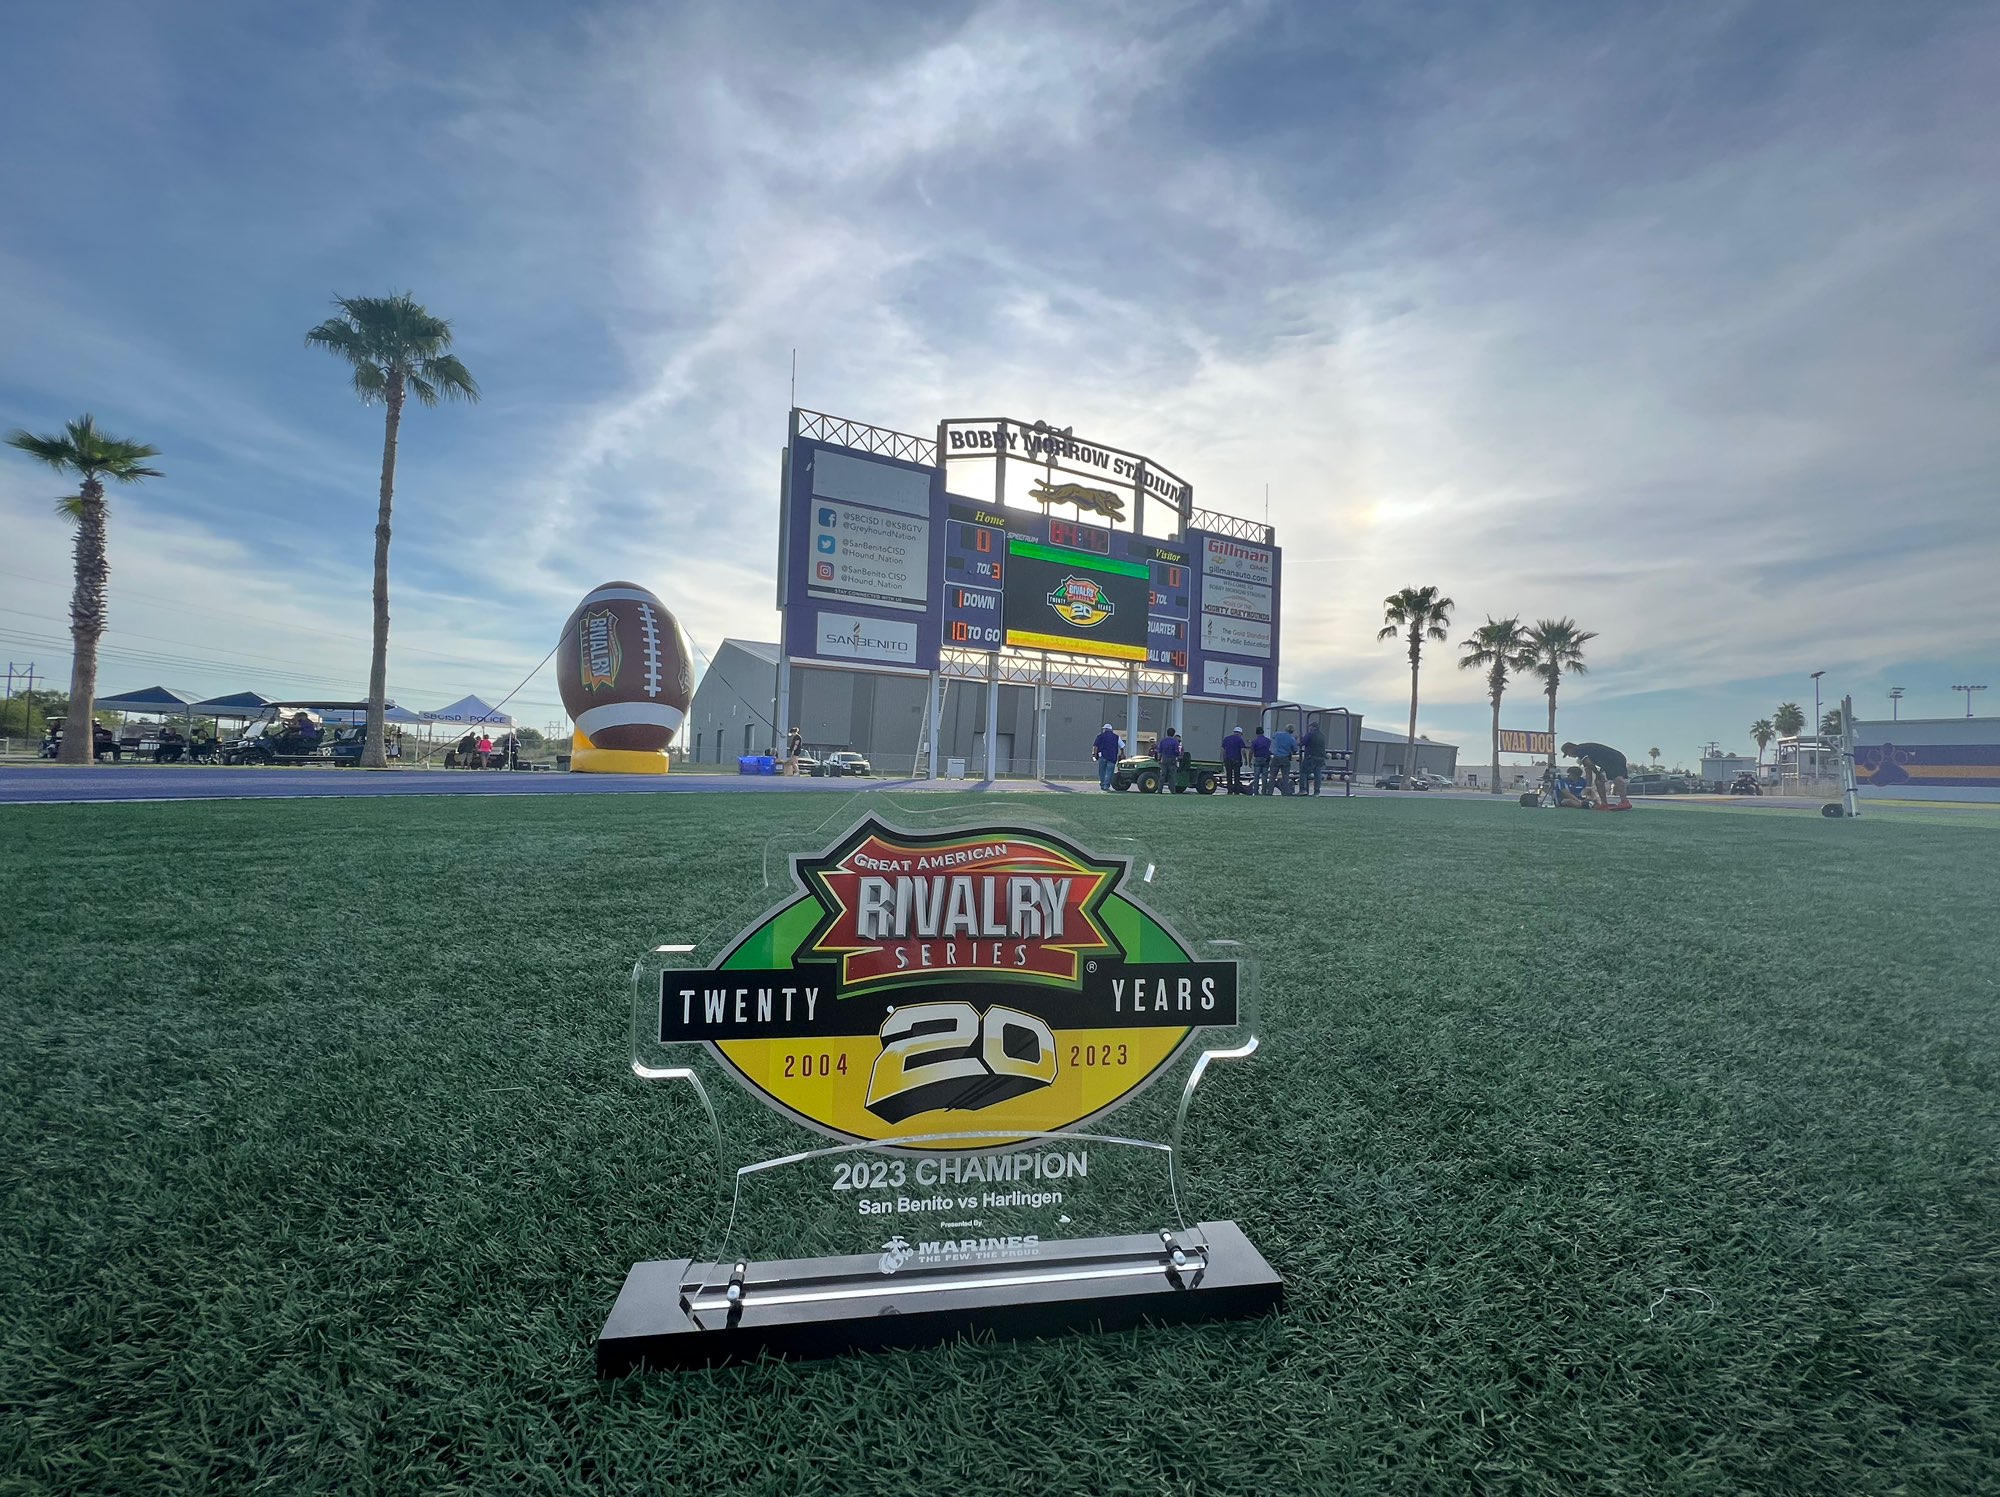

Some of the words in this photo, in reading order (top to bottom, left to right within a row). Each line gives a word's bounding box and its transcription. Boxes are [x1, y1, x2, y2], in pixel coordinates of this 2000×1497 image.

[949, 429, 1018, 450] BOBBY
[1024, 434, 1111, 470] MORROW
[1113, 457, 1187, 506] STADIUM
[843, 511, 879, 526] @SBCISD
[885, 520, 922, 533] @KSBGTV
[975, 510, 1005, 526] Home
[843, 521, 916, 541] @GreyhoundNation
[1006, 531, 1039, 544] SPECTRUM
[842, 538, 906, 556] @SanBenitoCISD
[842, 547, 903, 565] @Hound_Nation
[1155, 548, 1181, 562] Visitor
[1208, 539, 1269, 563] Gillman
[976, 562, 991, 576] TOL
[992, 562, 1001, 579] 3
[1209, 566, 1268, 583] gillmanauto.com
[1250, 564, 1269, 573] GMC
[841, 574, 903, 590] @Hound_Nation
[963, 592, 996, 610] DOWN
[1149, 590, 1156, 605] 3
[1156, 593, 1168, 605] TOL
[952, 621, 968, 641] 10
[967, 625, 981, 639] TO
[984, 627, 1000, 642] GO
[589, 617, 611, 678] RIVALRY
[1148, 649, 1159, 662] ALL
[1160, 651, 1171, 663] ON
[423, 712, 462, 721] SBCISD
[469, 715, 506, 723] POLICE
[1501, 731, 1528, 752] WAR
[1530, 733, 1554, 753] DOG
[854, 853, 912, 872] GREAT
[917, 843, 1008, 870] AMERICAN
[857, 876, 1073, 941] RIVALRY
[895, 943, 1027, 969] SERIES
[679, 987, 819, 1024] TWENTY
[1111, 977, 1216, 1012] YEARS
[784, 1053, 848, 1078] 2004
[1070, 1044, 1128, 1068] 2023
[865, 1000, 1059, 1125] 20
[832, 1160, 907, 1191] 2023
[915, 1151, 1088, 1186] CHAMPION
[858, 1199, 893, 1215] San
[897, 1195, 954, 1213] Benito
[957, 1196, 978, 1209] vs
[982, 1191, 1063, 1212] Harlingen
[940, 1219, 973, 1228] Presented
[973, 1219, 983, 1228] By
[919, 1235, 1039, 1255] MARINES
[919, 1254, 941, 1263] THE
[946, 1252, 973, 1262] FEW.
[975, 1251, 998, 1260] THE
